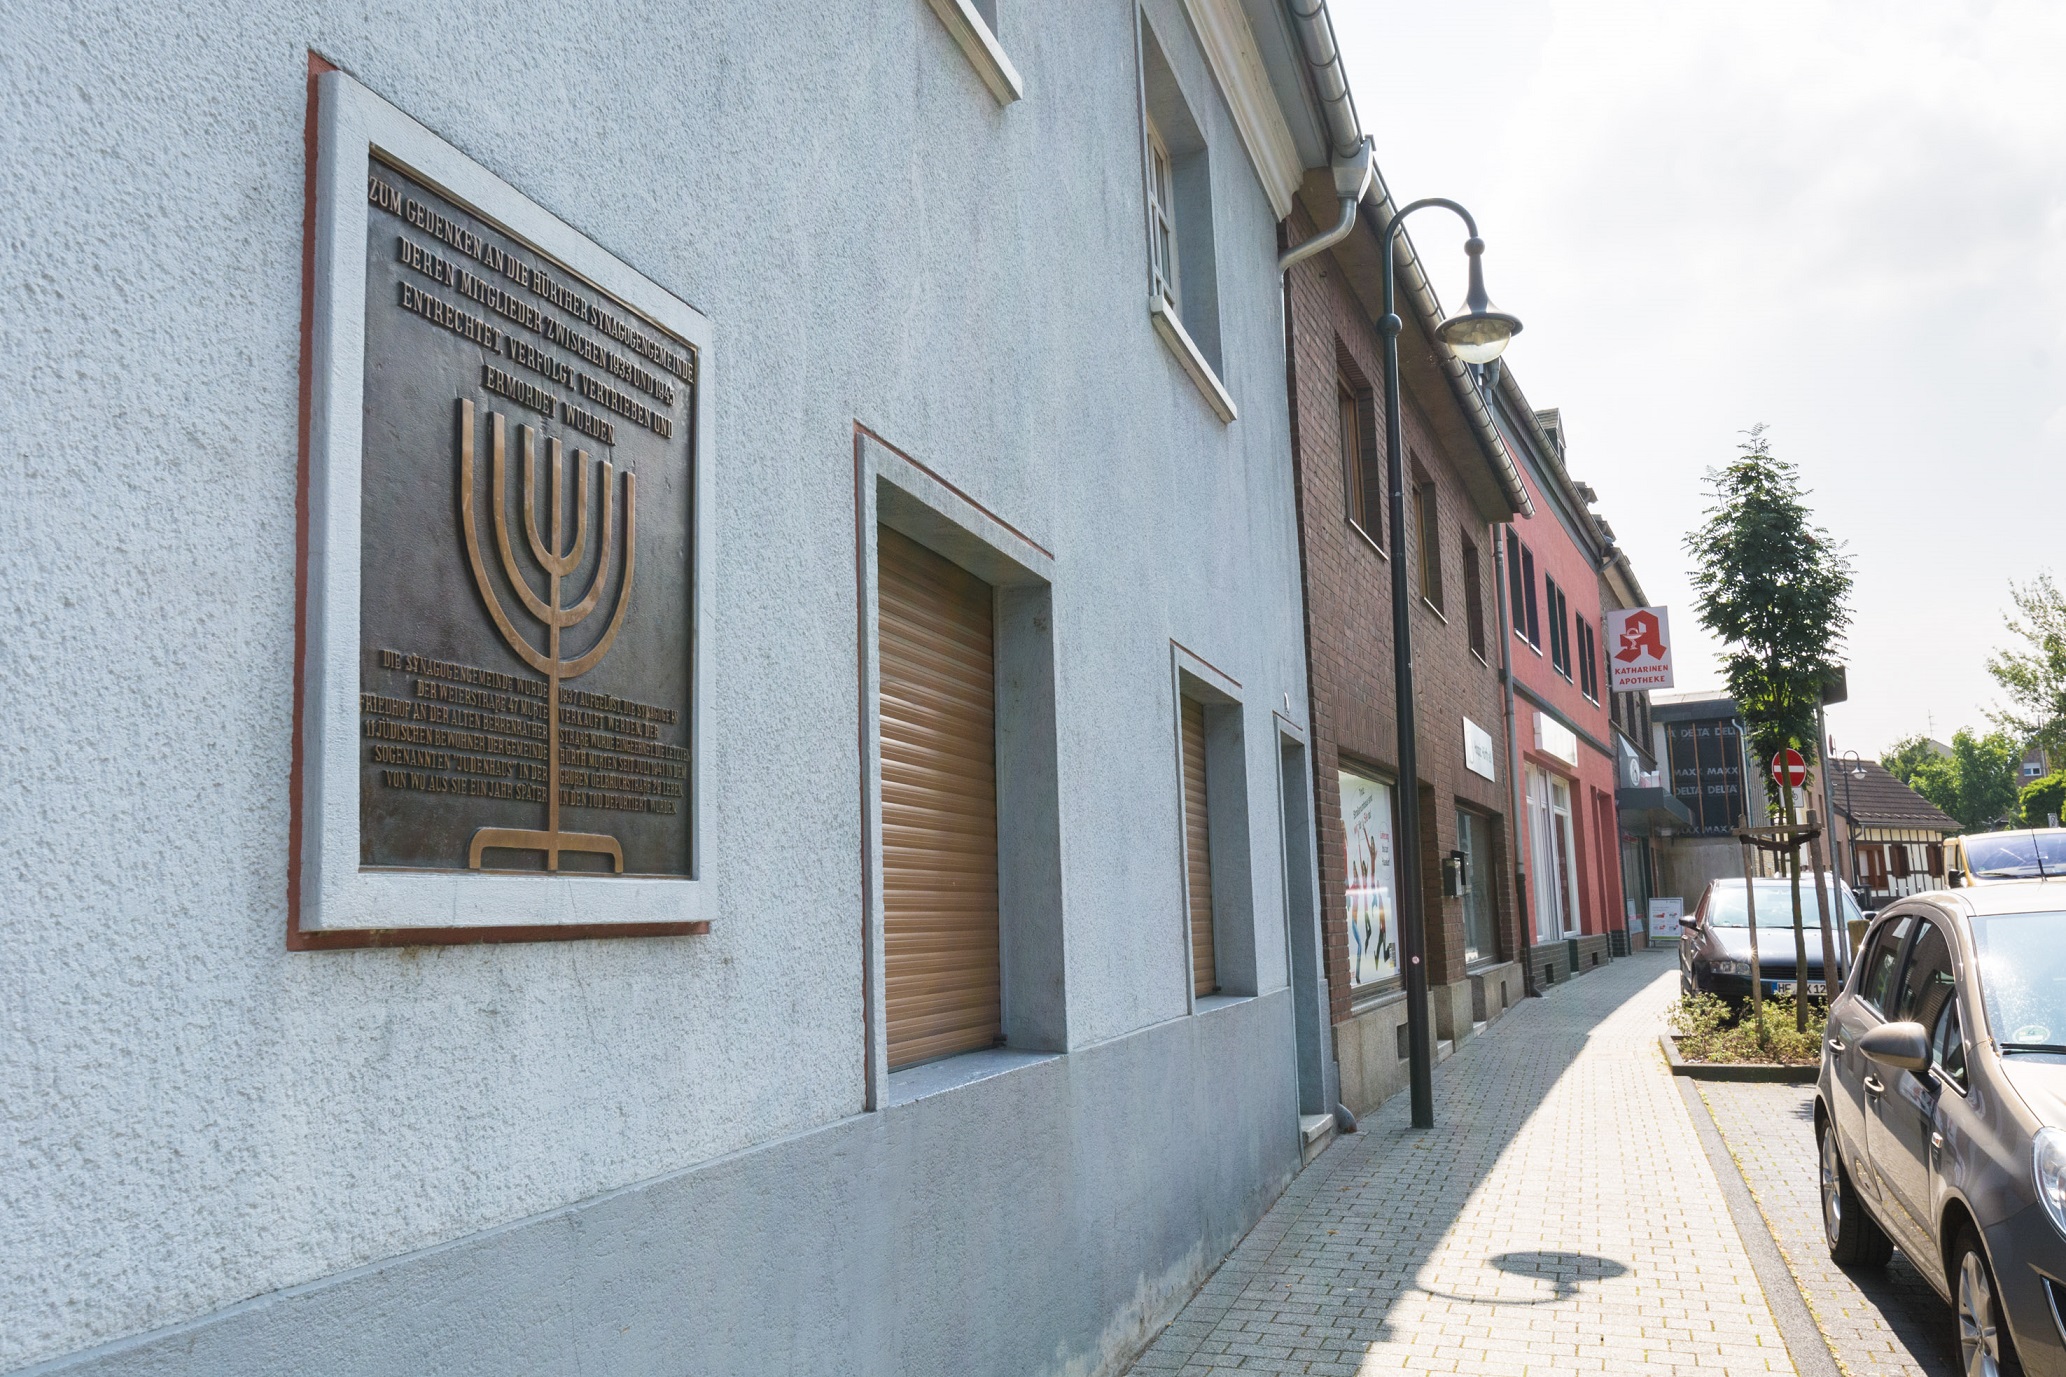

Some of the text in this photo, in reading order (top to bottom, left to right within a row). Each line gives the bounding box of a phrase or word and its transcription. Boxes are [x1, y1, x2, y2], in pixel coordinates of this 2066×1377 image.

[369, 176, 402, 216] ZUM
[406, 198, 482, 261] GEDENKEN
[484, 244, 504, 272] AN
[506, 254, 528, 286] DIE
[532, 268, 588, 321] HÜRTHER
[401, 238, 675, 406] DEREN MITGLIEDER ZWISCHEN 1933 UND 1945
[486, 365, 557, 418] ERMORDET
[582, 374, 651, 428] VERTRIEBEN
[654, 412, 674, 439] UND
[384, 650, 401, 669] DIE
[406, 652, 513, 690] SYNAGOGENGEMEINDE
[517, 678, 548, 698] WURDE
[560, 688, 578, 704] 1937
[624, 700, 635, 716] DIE
[1614, 664, 1668, 674] KATHARINEN
[1619, 676, 1665, 685] APOTHEKE
[360, 693, 411, 718] FRIEDHOF
[414, 702, 426, 721] AN
[430, 705, 449, 723] DER
[451, 709, 480, 728] ALTEN
[483, 714, 548, 739] BERRENRATHER
[591, 732, 614, 750] WURDE
[418, 680, 436, 699] DER
[508, 697, 519, 712] 47
[560, 708, 604, 728] VERKAUFT
[646, 722, 660, 738] DER
[366, 719, 374, 736] 11
[376, 718, 432, 744] JÜDISCHEN
[435, 729, 485, 750] BEWOHNER
[488, 736, 504, 753] DER
[506, 738, 548, 760] GEMEINDE
[619, 757, 634, 772] SEIT
[635, 760, 650, 774] JULI
[375, 745, 450, 769] SOGENANNTEN
[519, 763, 528, 778] IN
[531, 764, 548, 781] DER
[386, 770, 406, 788] VON
[410, 772, 425, 790] WO
[429, 775, 448, 792] AUS
[451, 777, 467, 794] SIE
[470, 778, 486, 796] EIN
[489, 781, 513, 799] JAHR
[516, 783, 548, 802] SPÄTER
[560, 789, 568, 805] IN
[570, 791, 586, 806] DEN
[589, 793, 602, 807] TOD
[605, 794, 647, 812] DEPORTIERT
